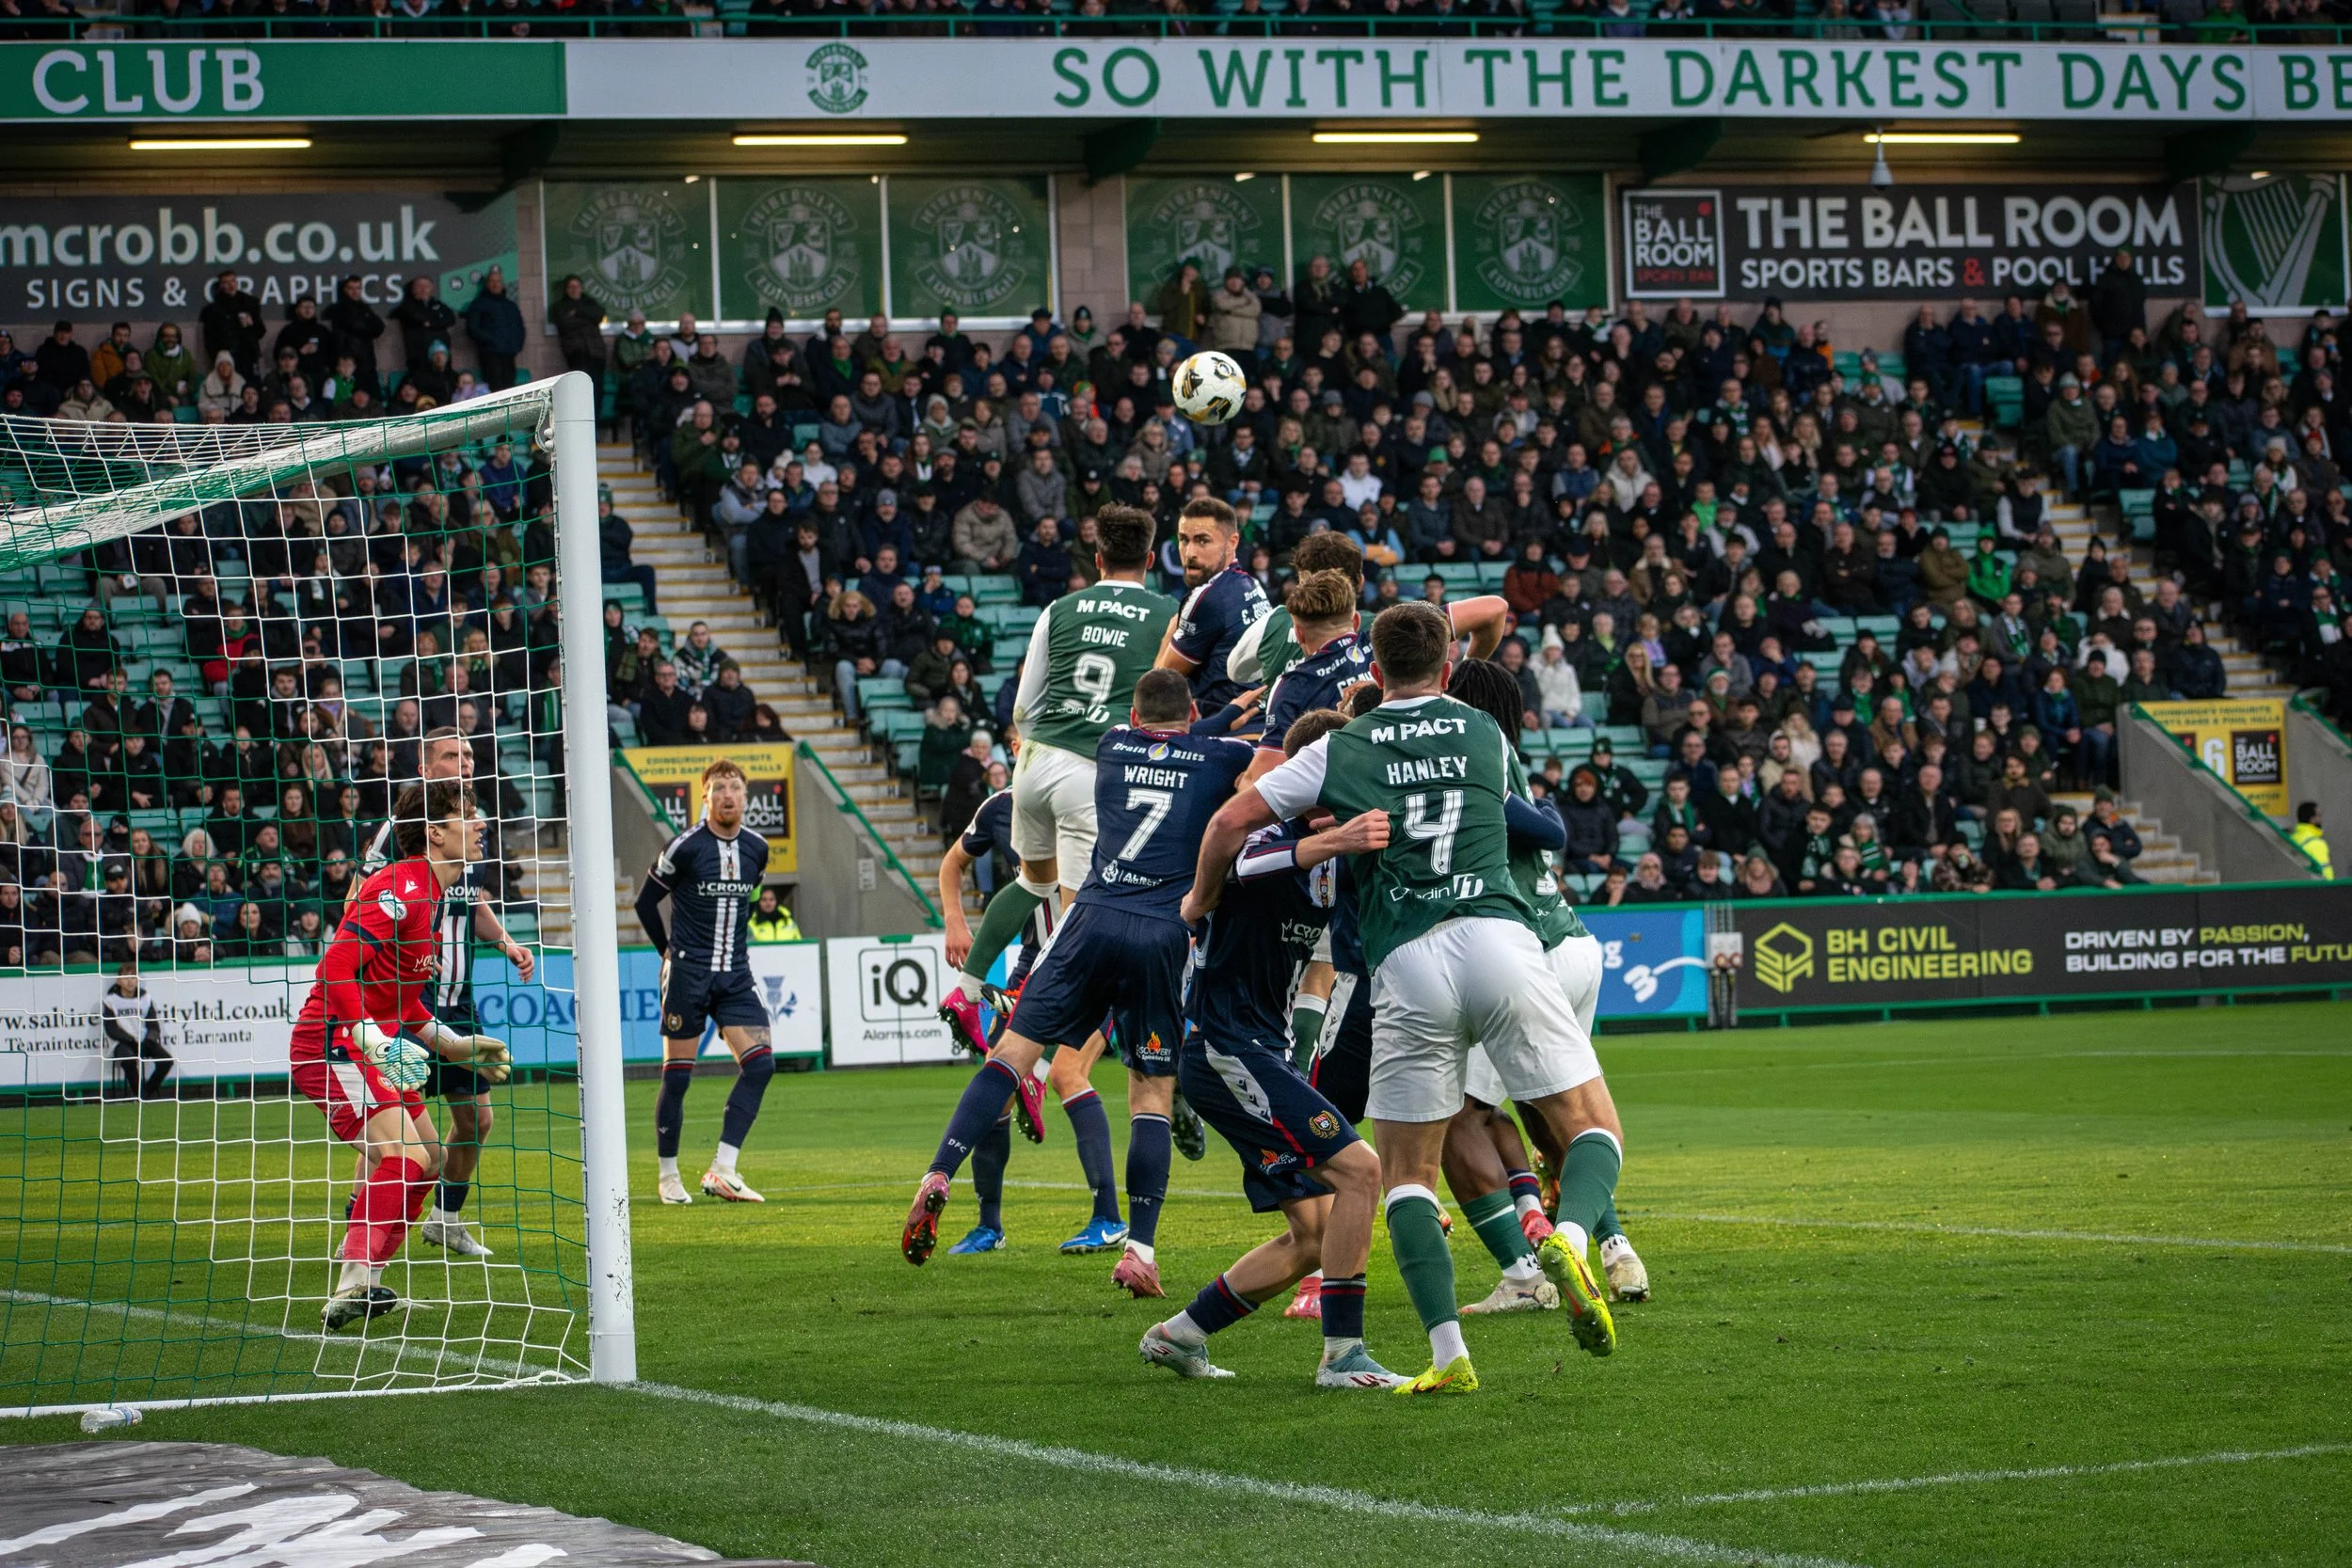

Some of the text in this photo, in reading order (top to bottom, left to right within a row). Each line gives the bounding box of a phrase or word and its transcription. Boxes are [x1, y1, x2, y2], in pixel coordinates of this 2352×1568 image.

[32, 49, 265, 113] CLUB
[1053, 48, 1161, 108] SO
[1199, 48, 1429, 108] WITH
[1465, 48, 1629, 108] THE
[1666, 50, 2022, 109] DARKEST
[2058, 53, 2247, 111] DAYS
[0, 205, 440, 267] mcrobb.co.uk
[1634, 217, 1714, 243] BALL
[1737, 195, 2183, 249] THE BALL ROOM
[1635, 243, 1714, 267] ROOM
[1740, 255, 2185, 289] SPORTS BARS & POOL HLLS
[26, 273, 405, 309] SIGNS & GRAPHCS
[1076, 599, 1150, 622] M PACT
[1081, 626, 1130, 648] BOWIE
[1062, 653, 1116, 709] 9
[1371, 718, 1467, 745] M PACT
[1112, 742, 1205, 762] Drain Blitz
[2203, 737, 2226, 779] 6
[2235, 742, 2276, 761] BALL
[1123, 765, 1188, 788] WRIGHT
[1386, 756, 1468, 785] HANLEY
[2236, 759, 2278, 773] ROOM
[1118, 787, 1174, 862] 7
[1403, 789, 1464, 877] 4
[1826, 927, 1956, 955] BH CIVIL
[2065, 924, 2310, 949] DRIVEN BY PASSION,
[1827, 949, 2033, 982] ENGINEERING
[2066, 951, 2179, 973] BUILDING
[2183, 949, 2235, 968] FOR
[2237, 946, 2286, 965] THE
[871, 958, 928, 1008] iQ
[862, 1028, 943, 1041] Alarms.com
[947, 1138, 967, 1153] DFC
